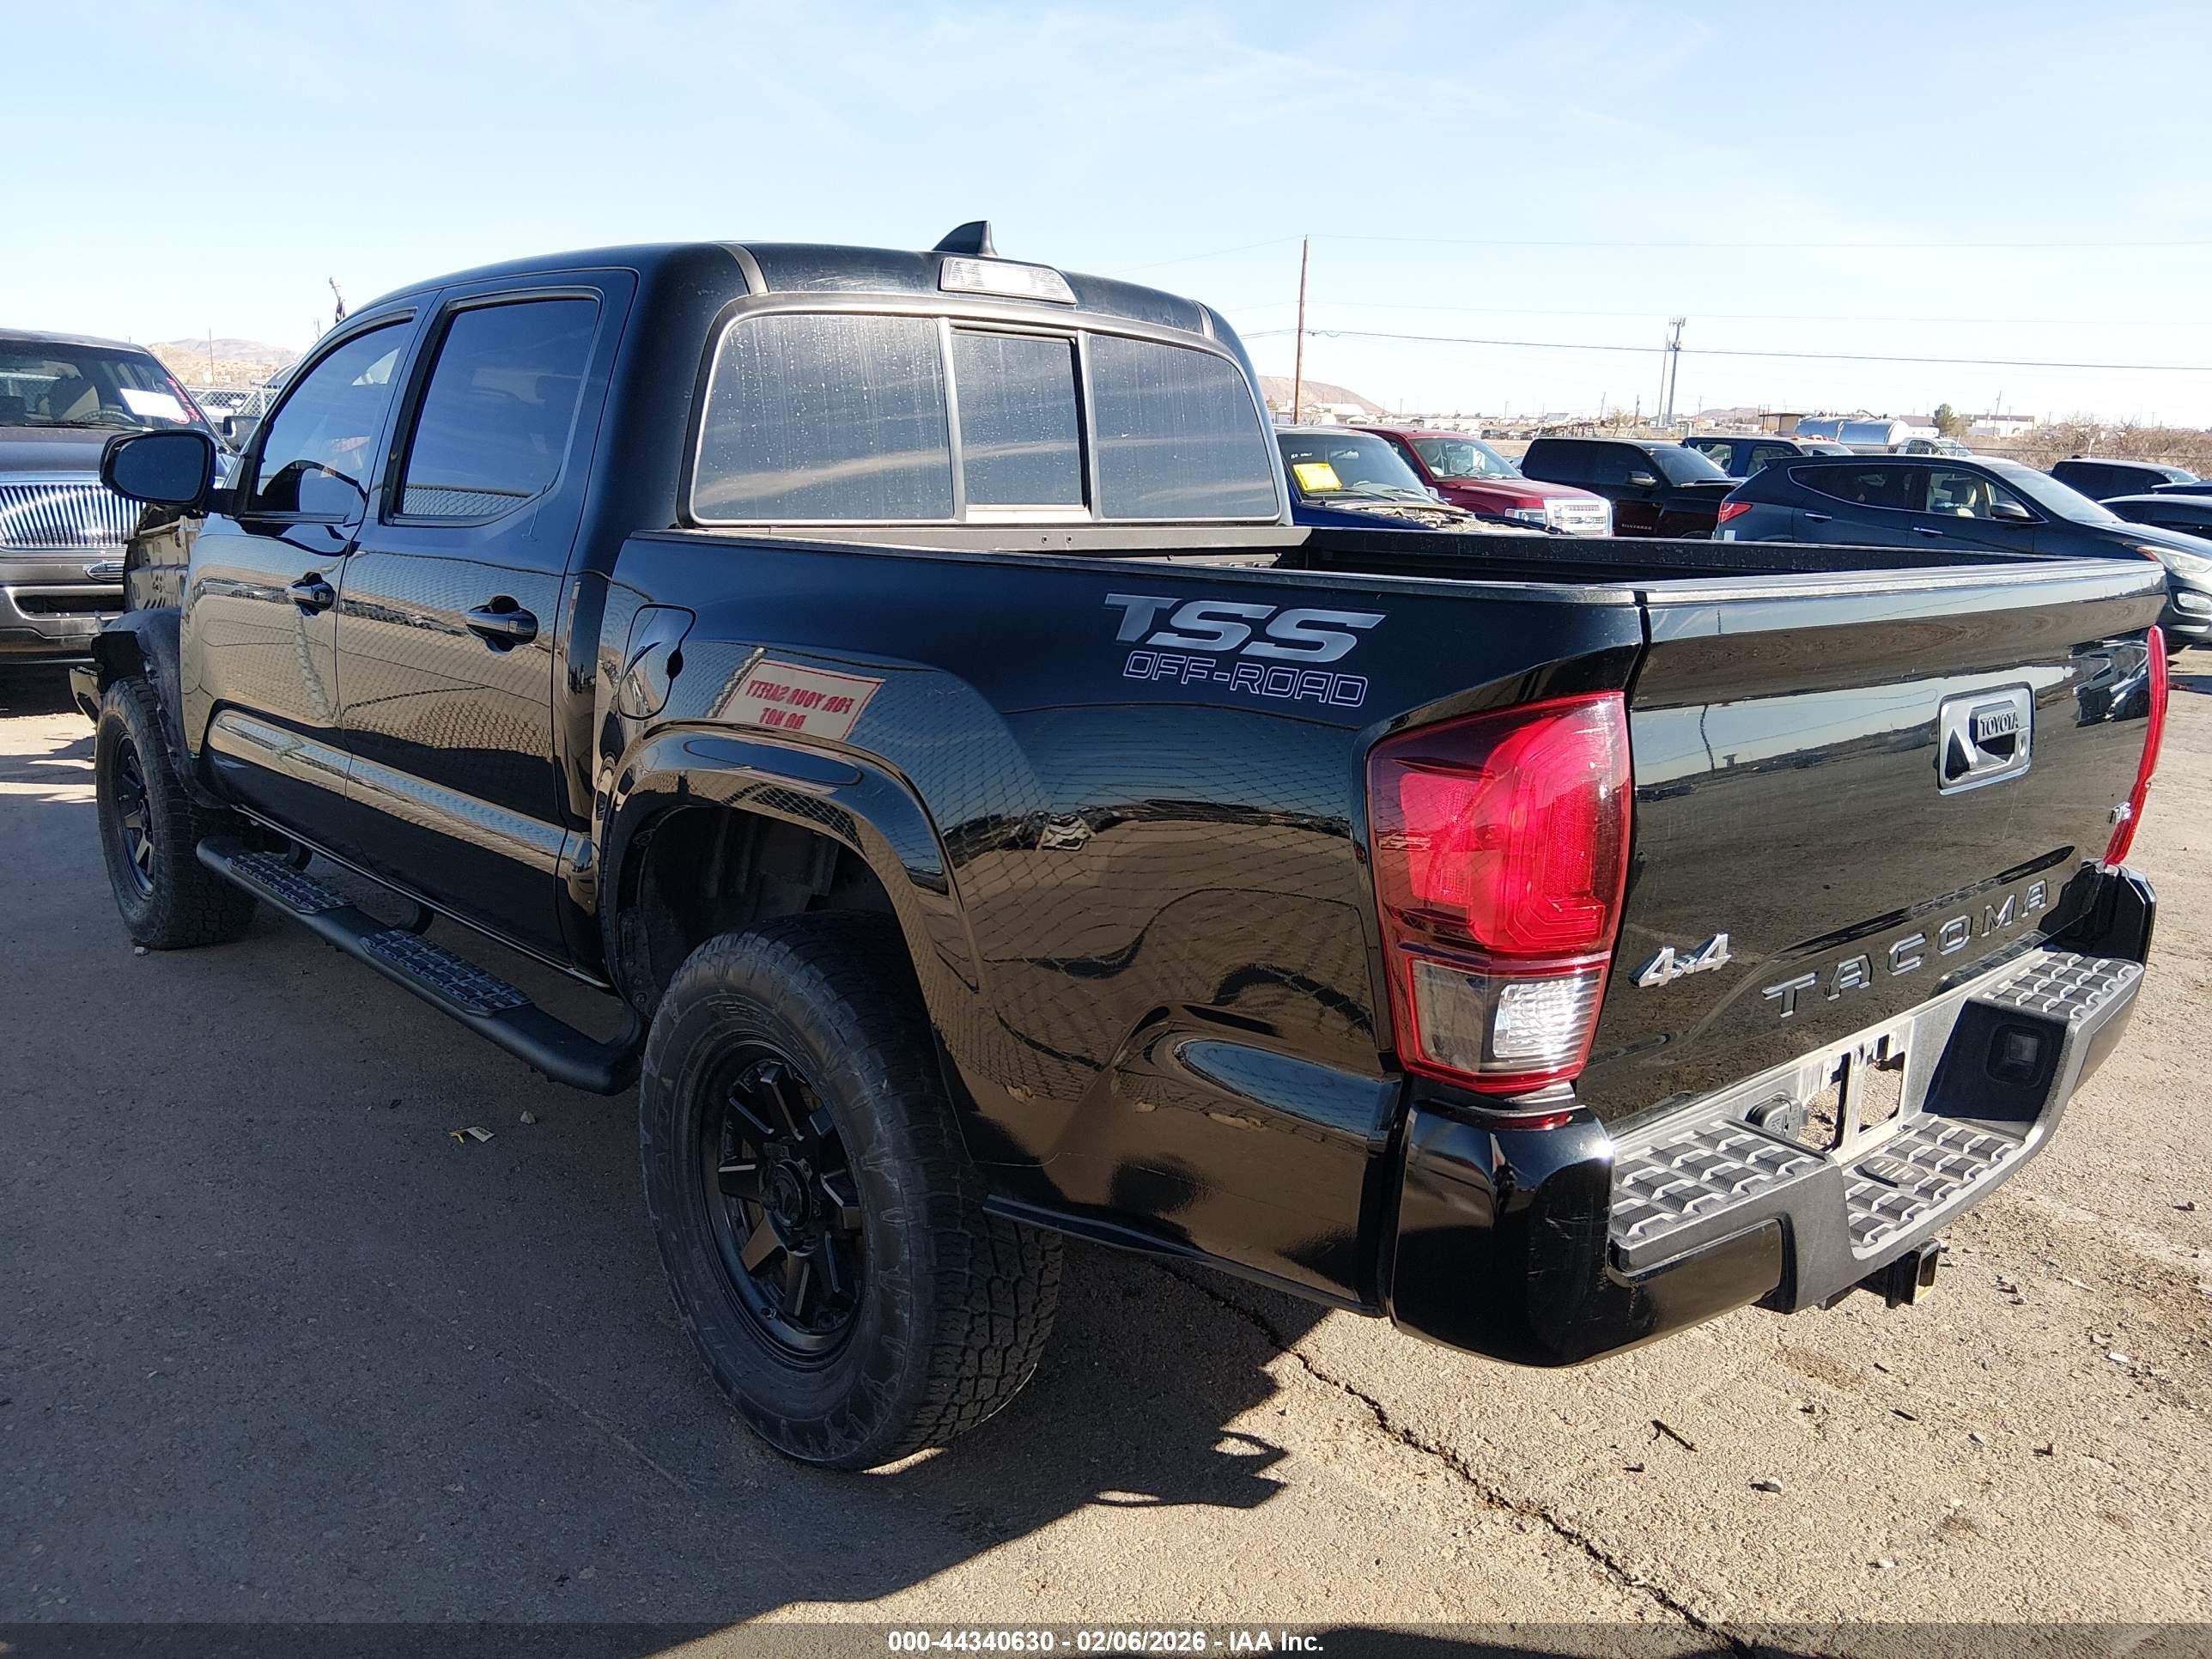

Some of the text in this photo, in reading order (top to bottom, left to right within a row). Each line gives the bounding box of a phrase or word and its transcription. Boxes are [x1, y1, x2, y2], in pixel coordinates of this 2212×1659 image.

[1104, 592, 1388, 663] TSS
[1122, 649, 1369, 708] OFF-ROAD
[1979, 711, 2019, 737] TOYOTA
[1761, 878, 2049, 1019] TACOMA
